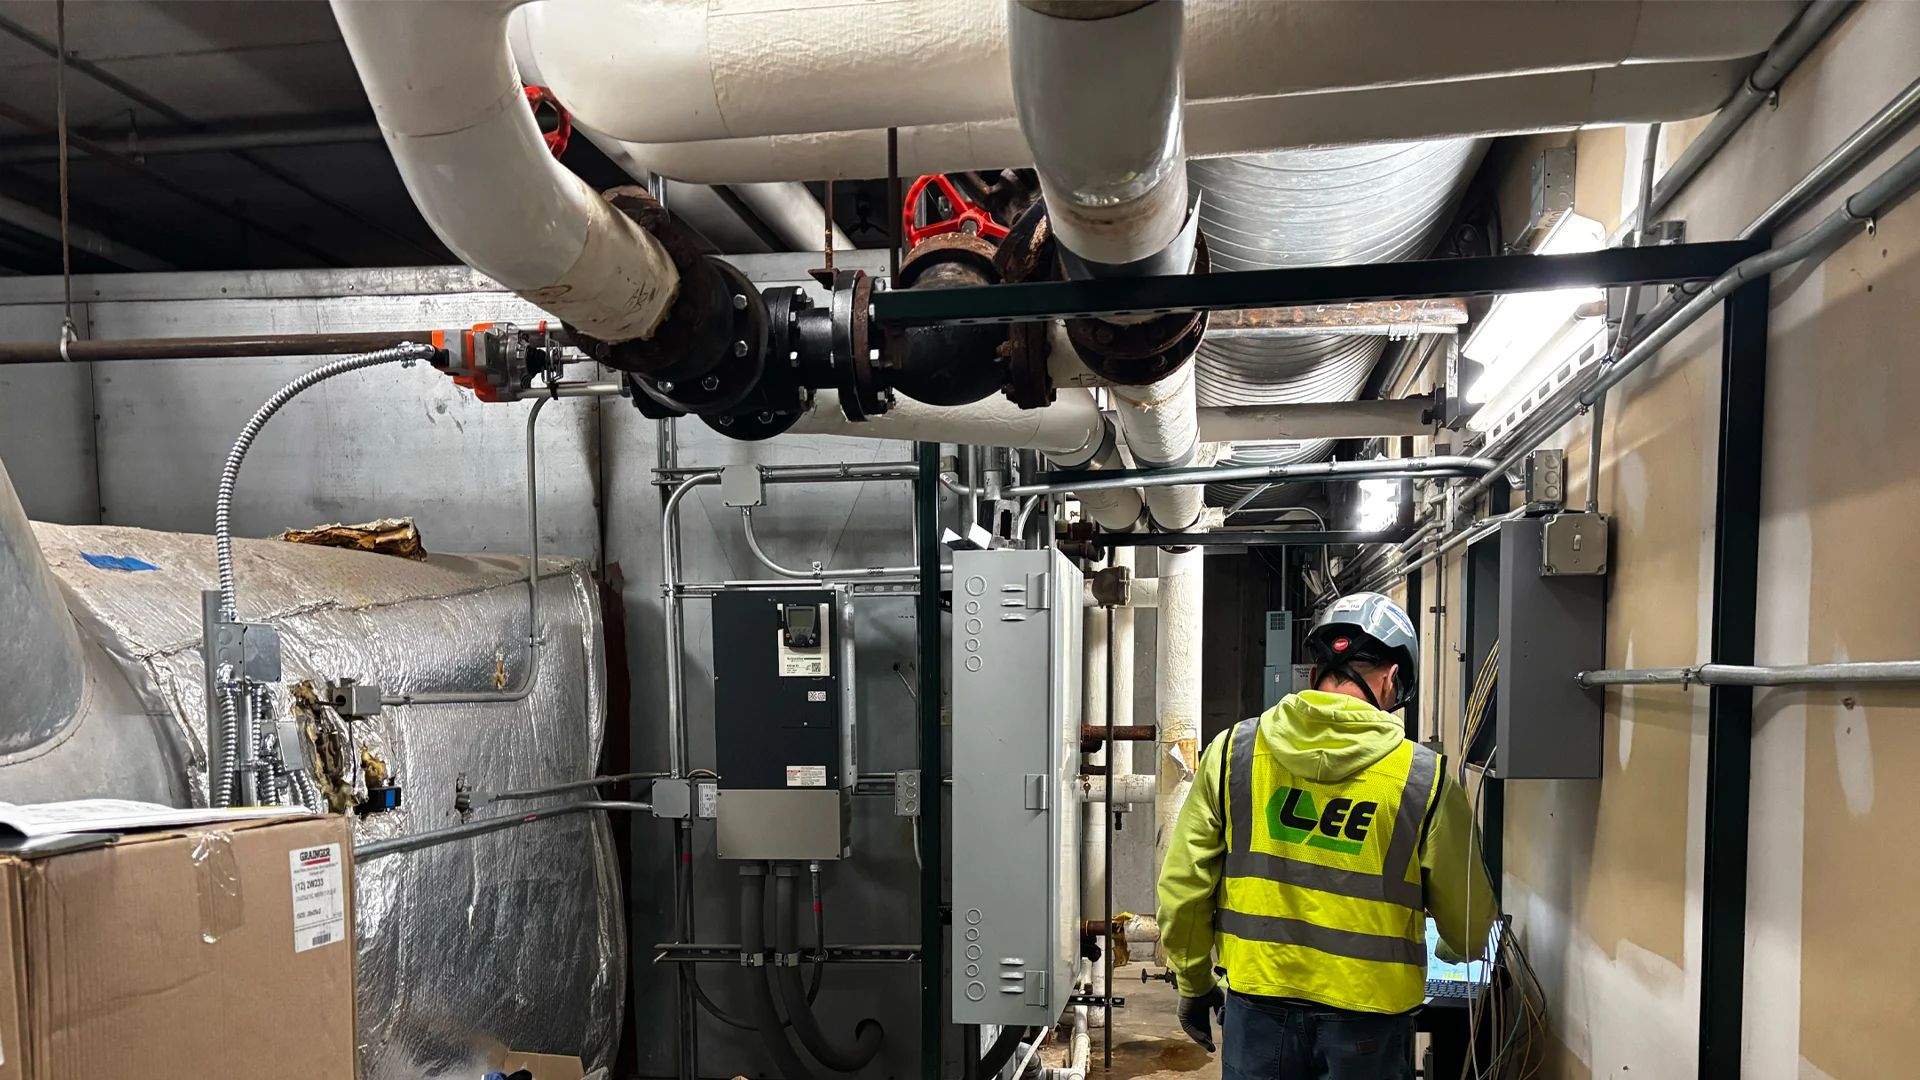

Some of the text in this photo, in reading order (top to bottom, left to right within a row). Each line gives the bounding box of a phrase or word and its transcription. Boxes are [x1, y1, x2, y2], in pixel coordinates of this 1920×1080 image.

[1280, 787, 1378, 842] LEE
[300, 848, 331, 862] GRAINGER
[295, 881, 306, 893] (12)
